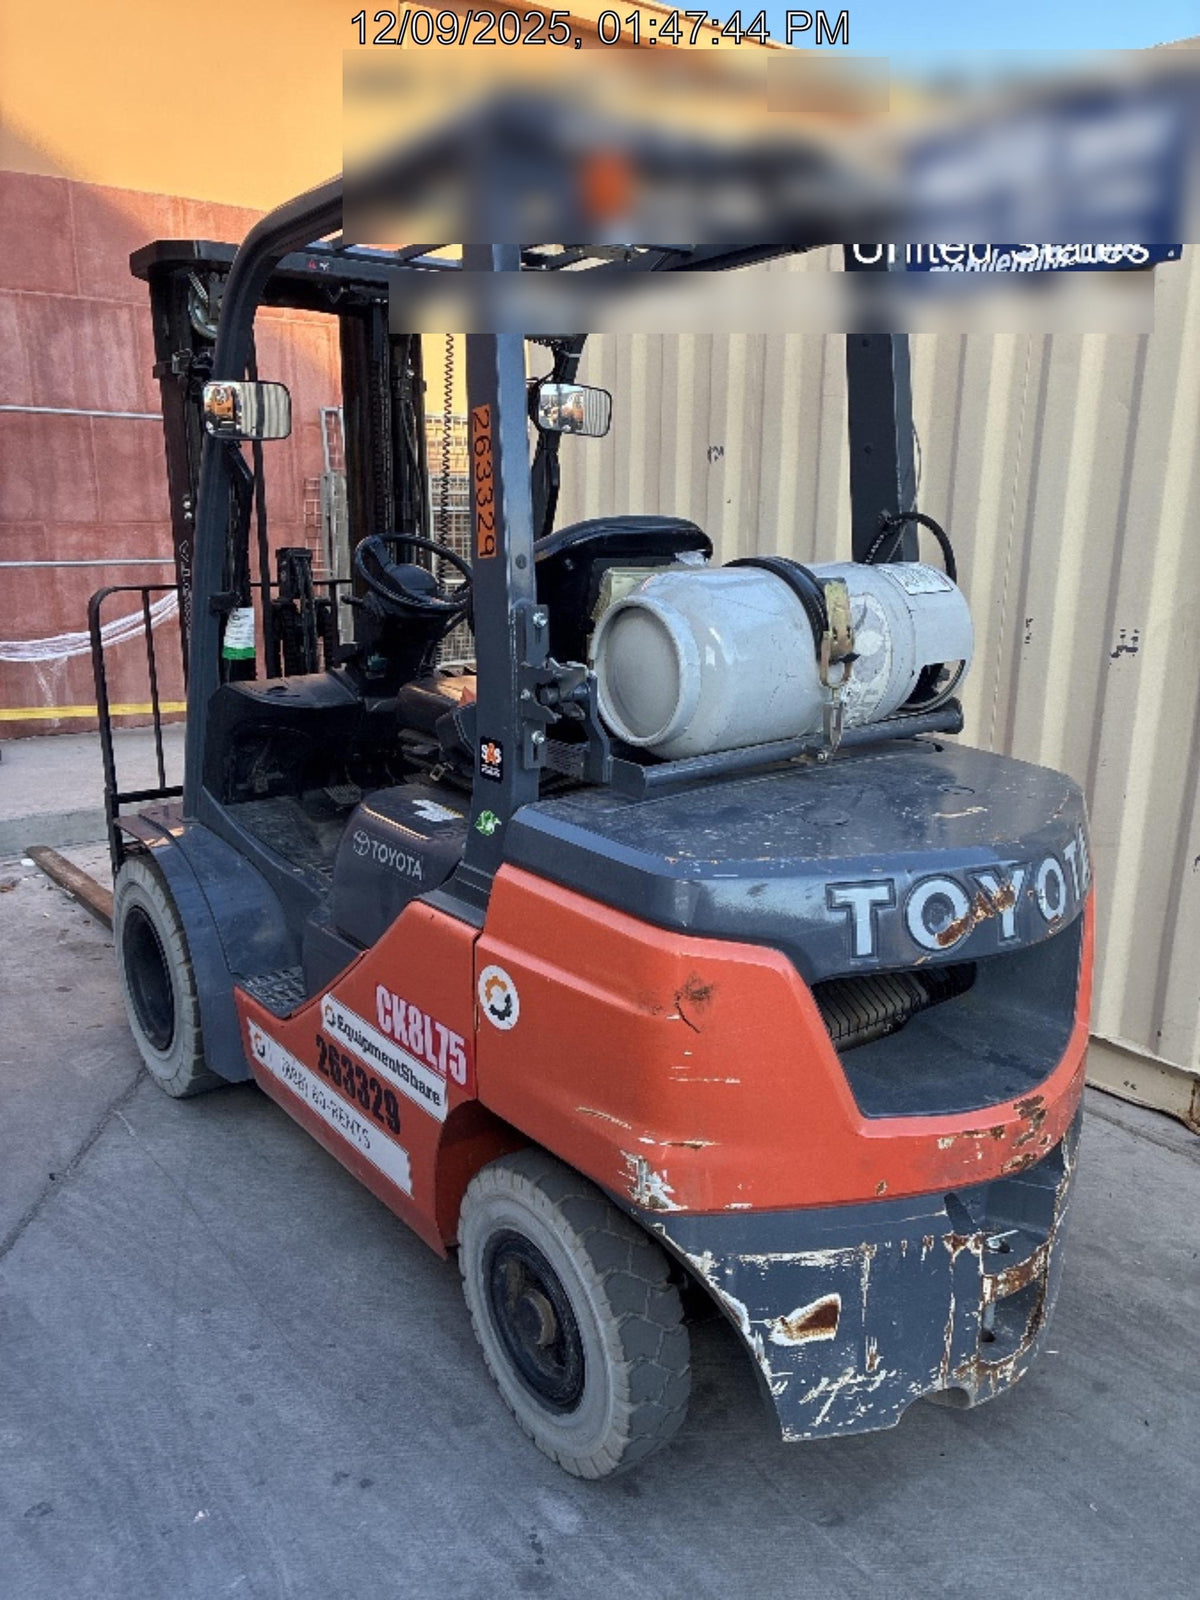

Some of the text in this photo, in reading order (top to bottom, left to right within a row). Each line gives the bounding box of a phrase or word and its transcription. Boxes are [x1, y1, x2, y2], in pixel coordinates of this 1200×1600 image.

[472, 408, 496, 557] 263329
[371, 840, 423, 881] TOYOTA
[315, 1034, 401, 1136] 263329
[337, 1013, 441, 1107] EquipmentShare
[375, 983, 467, 1086] CK8L75
